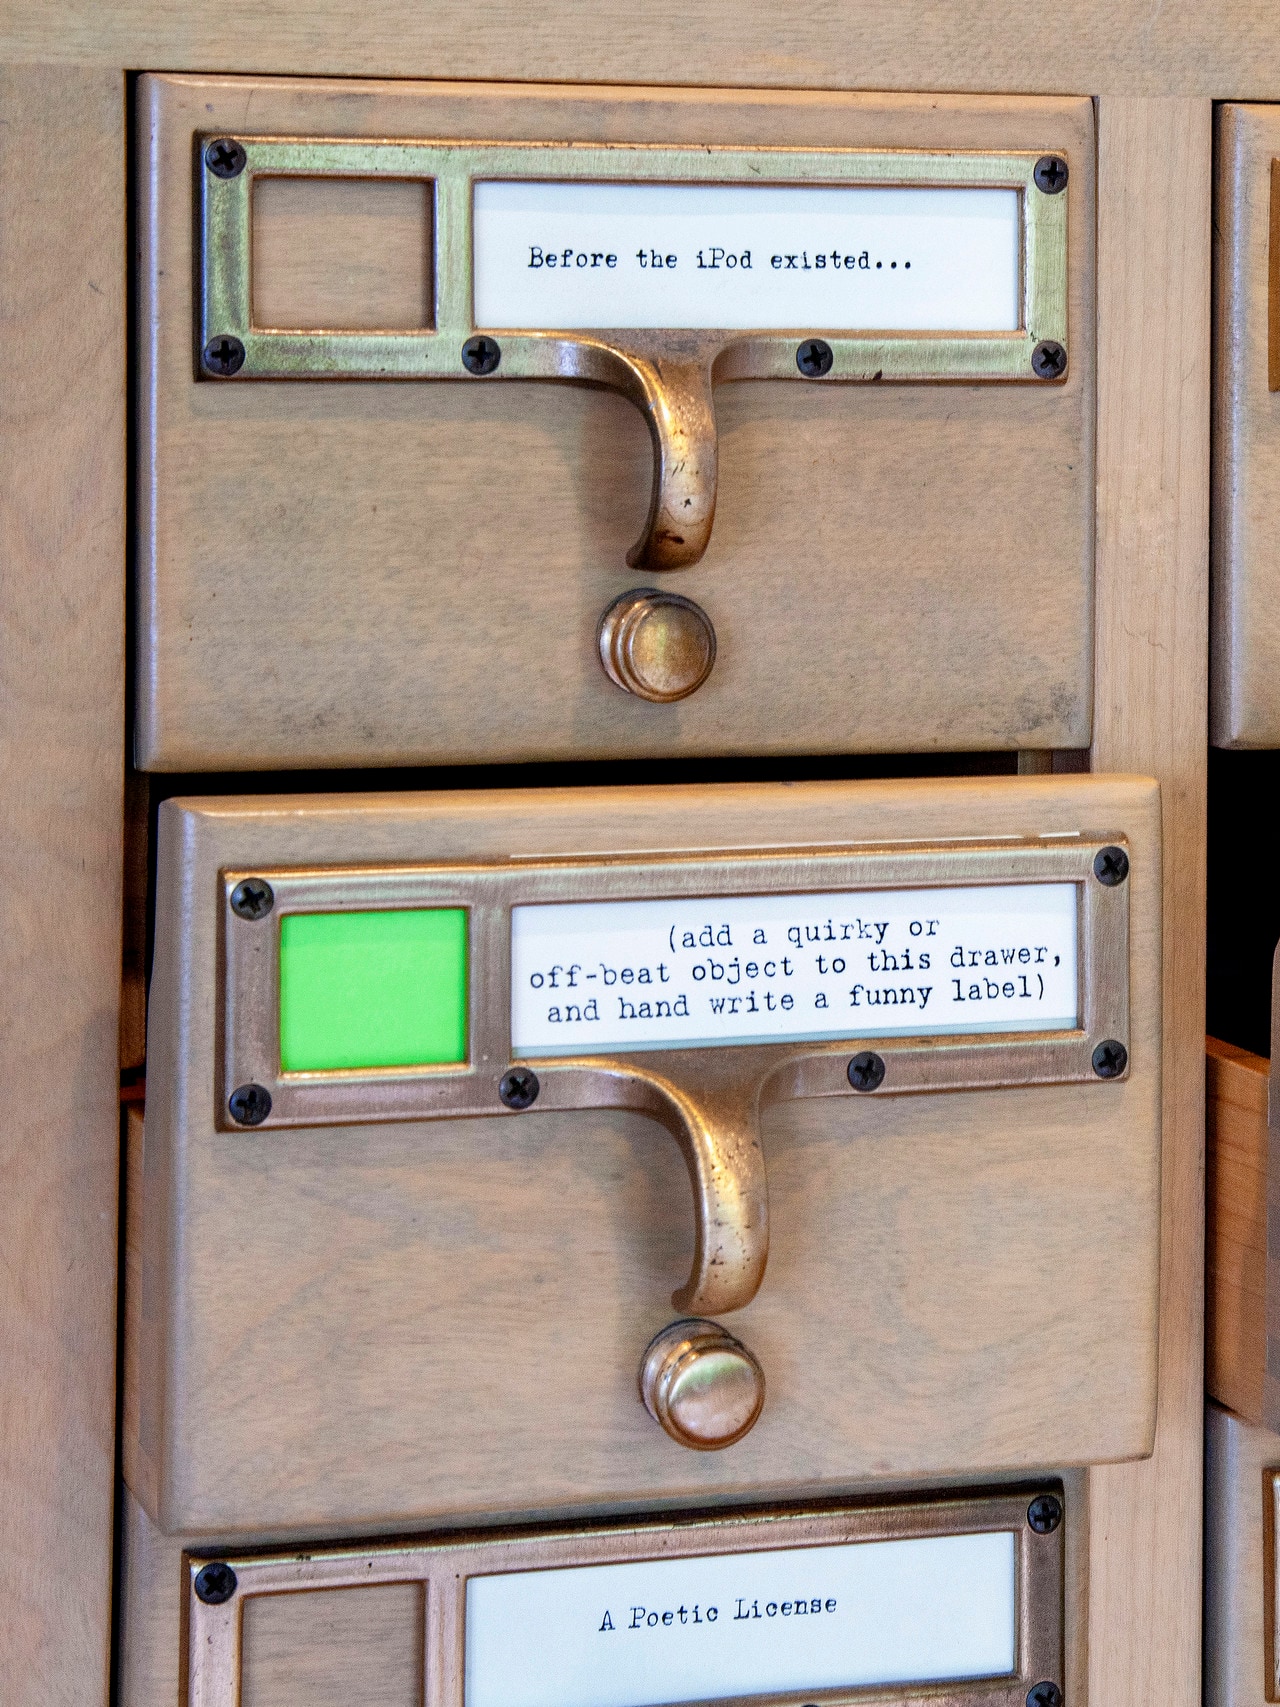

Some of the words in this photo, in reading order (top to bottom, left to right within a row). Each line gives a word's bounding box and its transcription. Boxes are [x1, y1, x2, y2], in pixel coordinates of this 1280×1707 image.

[528, 246, 618, 268] Before
[636, 249, 678, 268] the
[696, 247, 752, 268] iPod
[669, 925, 732, 952] (add
[752, 929, 768, 945] a
[787, 917, 891, 946] quirky
[908, 917, 941, 937] or
[529, 962, 670, 990] off-beat
[691, 957, 795, 982] object
[815, 957, 847, 974] to
[867, 947, 932, 972] this
[949, 941, 1062, 968] drawer,
[547, 998, 600, 1024] and
[618, 993, 691, 1019] hand
[709, 991, 795, 1015] write
[814, 991, 829, 1010] a
[849, 984, 934, 1008] funny
[952, 974, 1046, 1002] label)
[598, 1610, 616, 1632] A
[628, 1604, 719, 1629] Poetic
[733, 1595, 838, 1621] License
